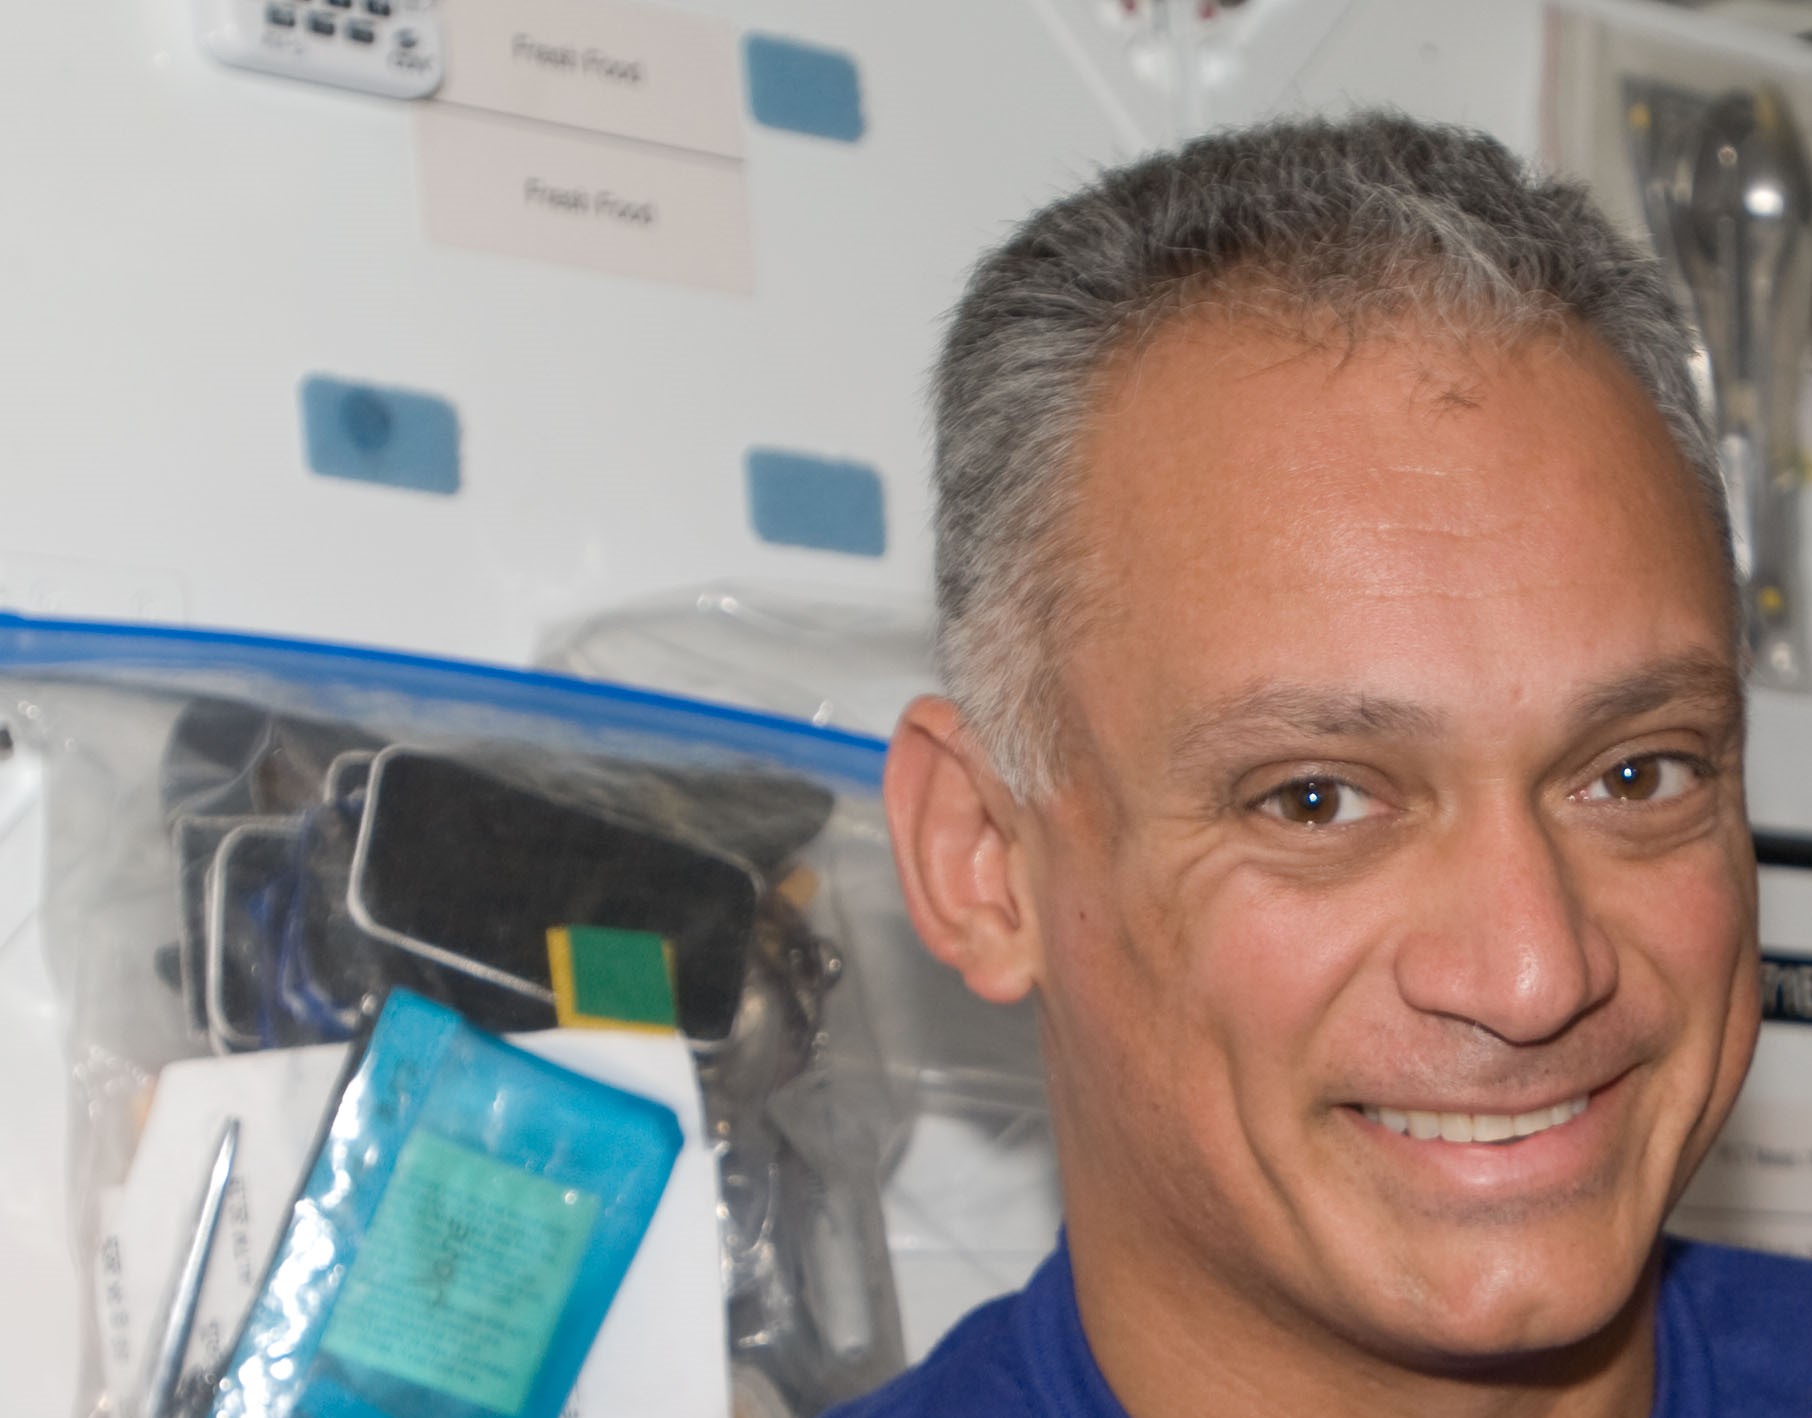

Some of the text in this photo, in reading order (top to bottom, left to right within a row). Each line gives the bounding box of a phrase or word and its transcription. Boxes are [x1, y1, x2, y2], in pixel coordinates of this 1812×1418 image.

[511, 32, 643, 83] Fresh Food
[524, 176, 655, 225] Fresh Food
